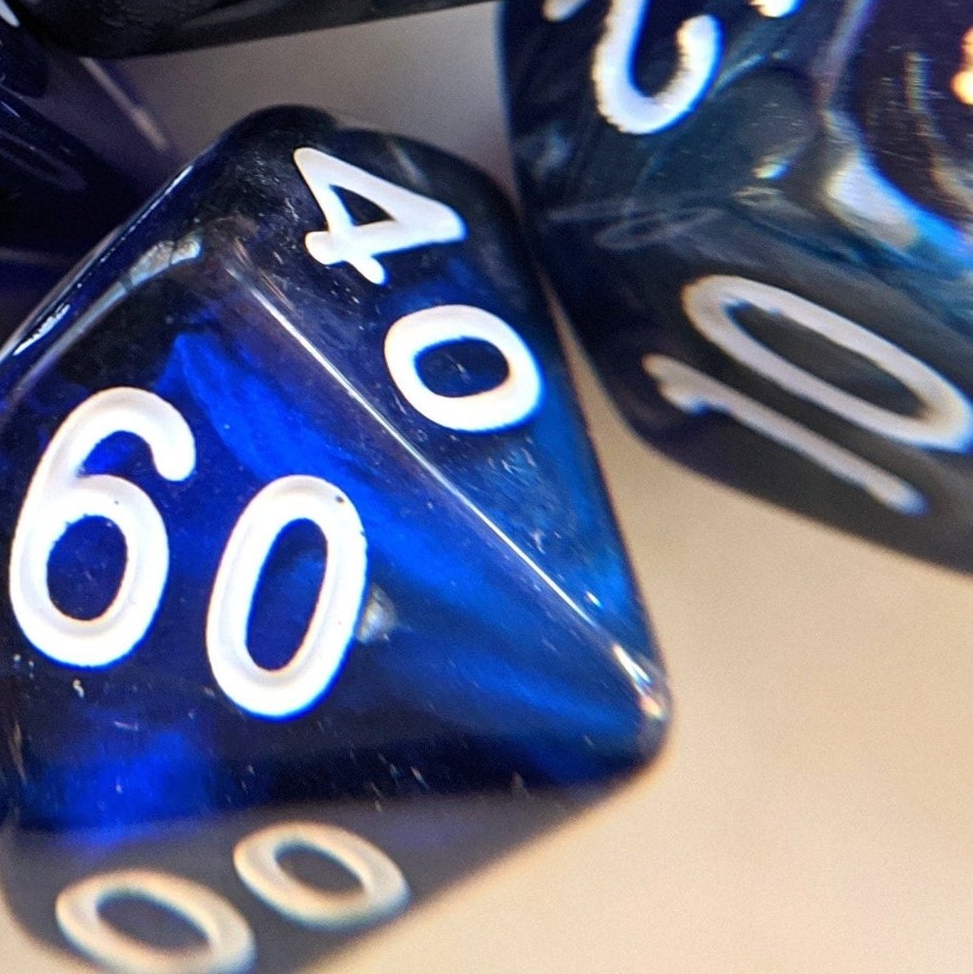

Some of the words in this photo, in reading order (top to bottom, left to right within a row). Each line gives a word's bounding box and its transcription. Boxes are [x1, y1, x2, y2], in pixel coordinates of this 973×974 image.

[293, 147, 542, 432] 40
[643, 273, 973, 515] 10
[9, 387, 368, 719] 60
[55, 822, 412, 974] 00
